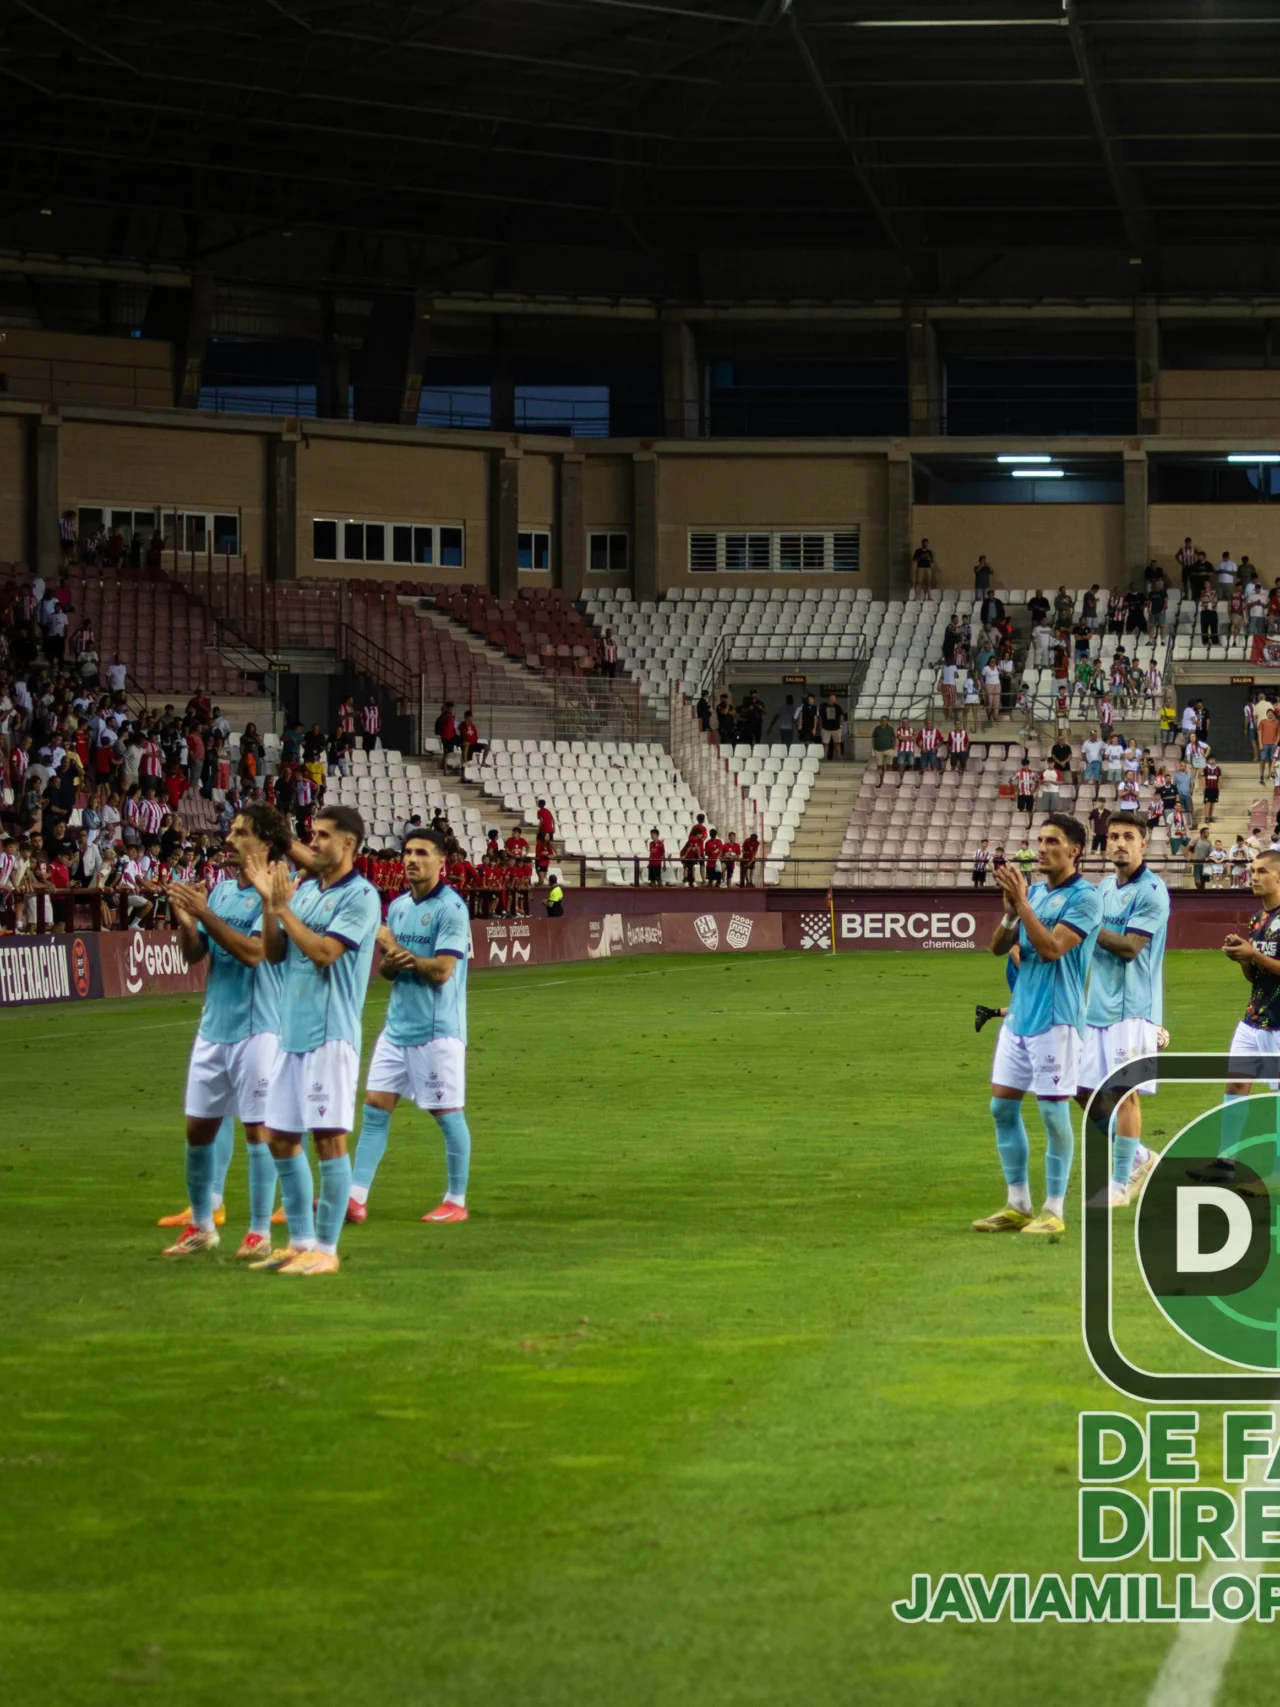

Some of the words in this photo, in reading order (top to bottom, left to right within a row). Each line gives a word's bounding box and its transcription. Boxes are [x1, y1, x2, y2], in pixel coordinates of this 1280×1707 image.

[841, 912, 976, 938] BERCEO
[394, 930, 431, 946] elepizza
[923, 940, 975, 949] chemicals
[0, 936, 70, 1002] FEDERACIÓN
